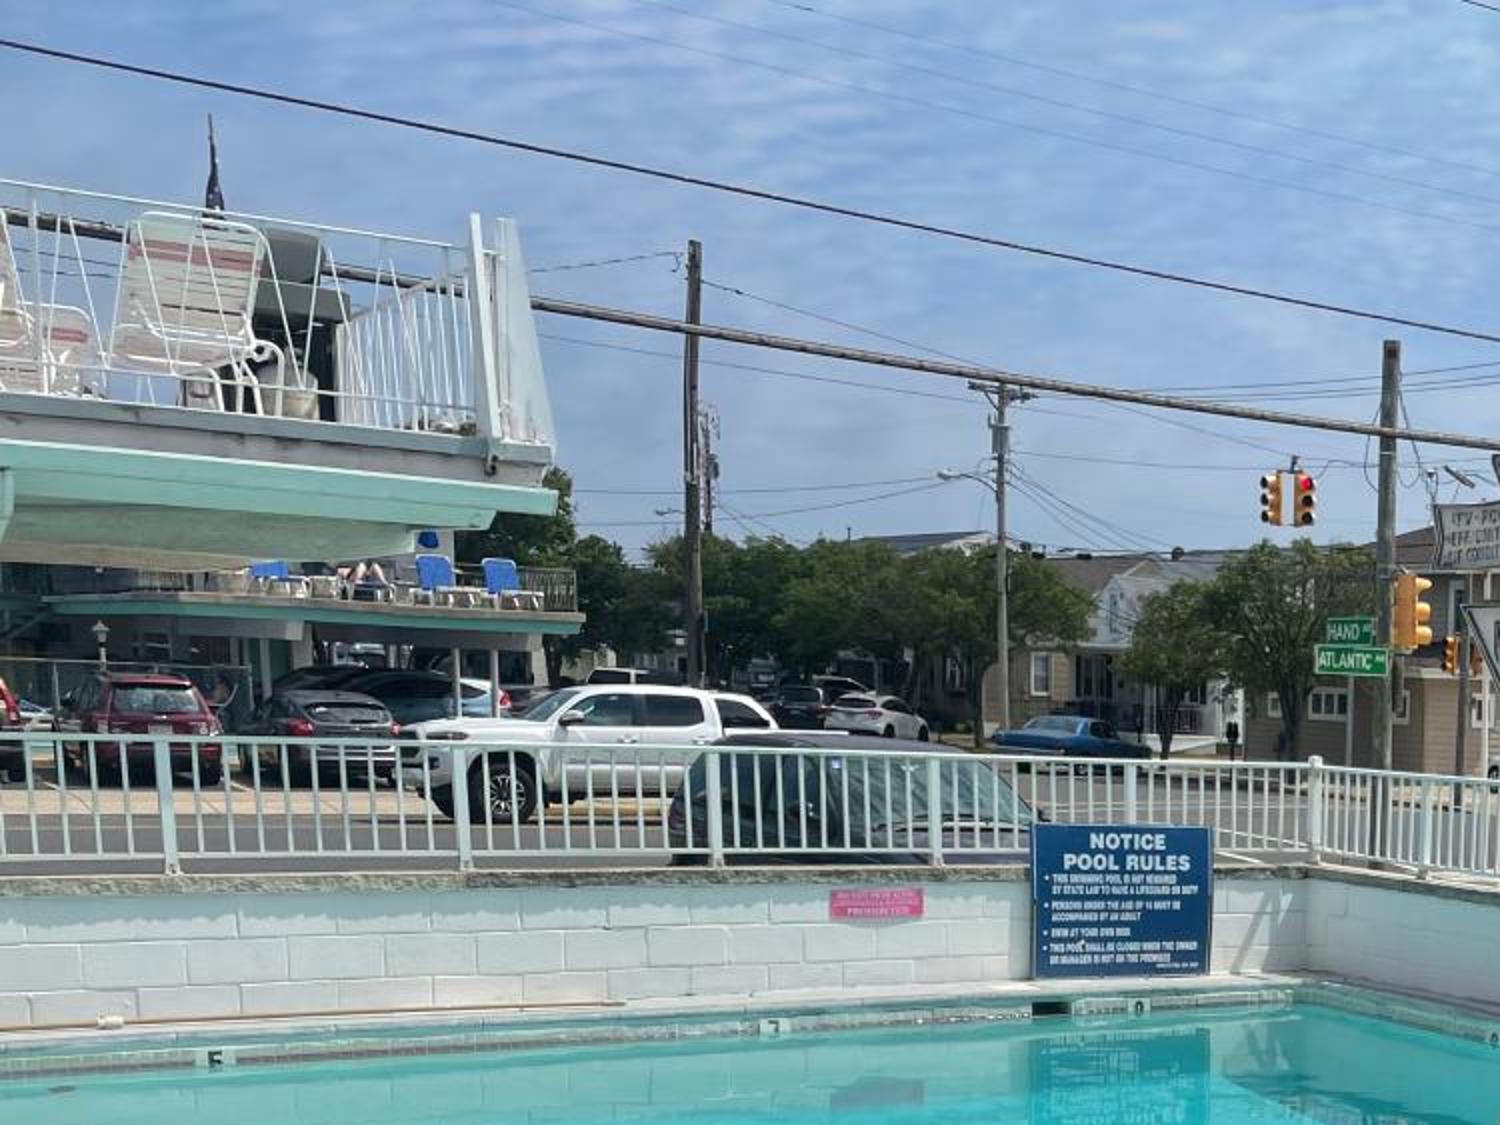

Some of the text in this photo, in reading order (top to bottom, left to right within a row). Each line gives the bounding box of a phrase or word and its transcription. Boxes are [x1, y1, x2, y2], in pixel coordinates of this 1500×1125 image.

[1327, 623, 1361, 641] HAND
[1319, 650, 1373, 671] ATLANTIC
[1090, 833, 1167, 850] NOTICE
[1064, 854, 1191, 872] POOL RULES
